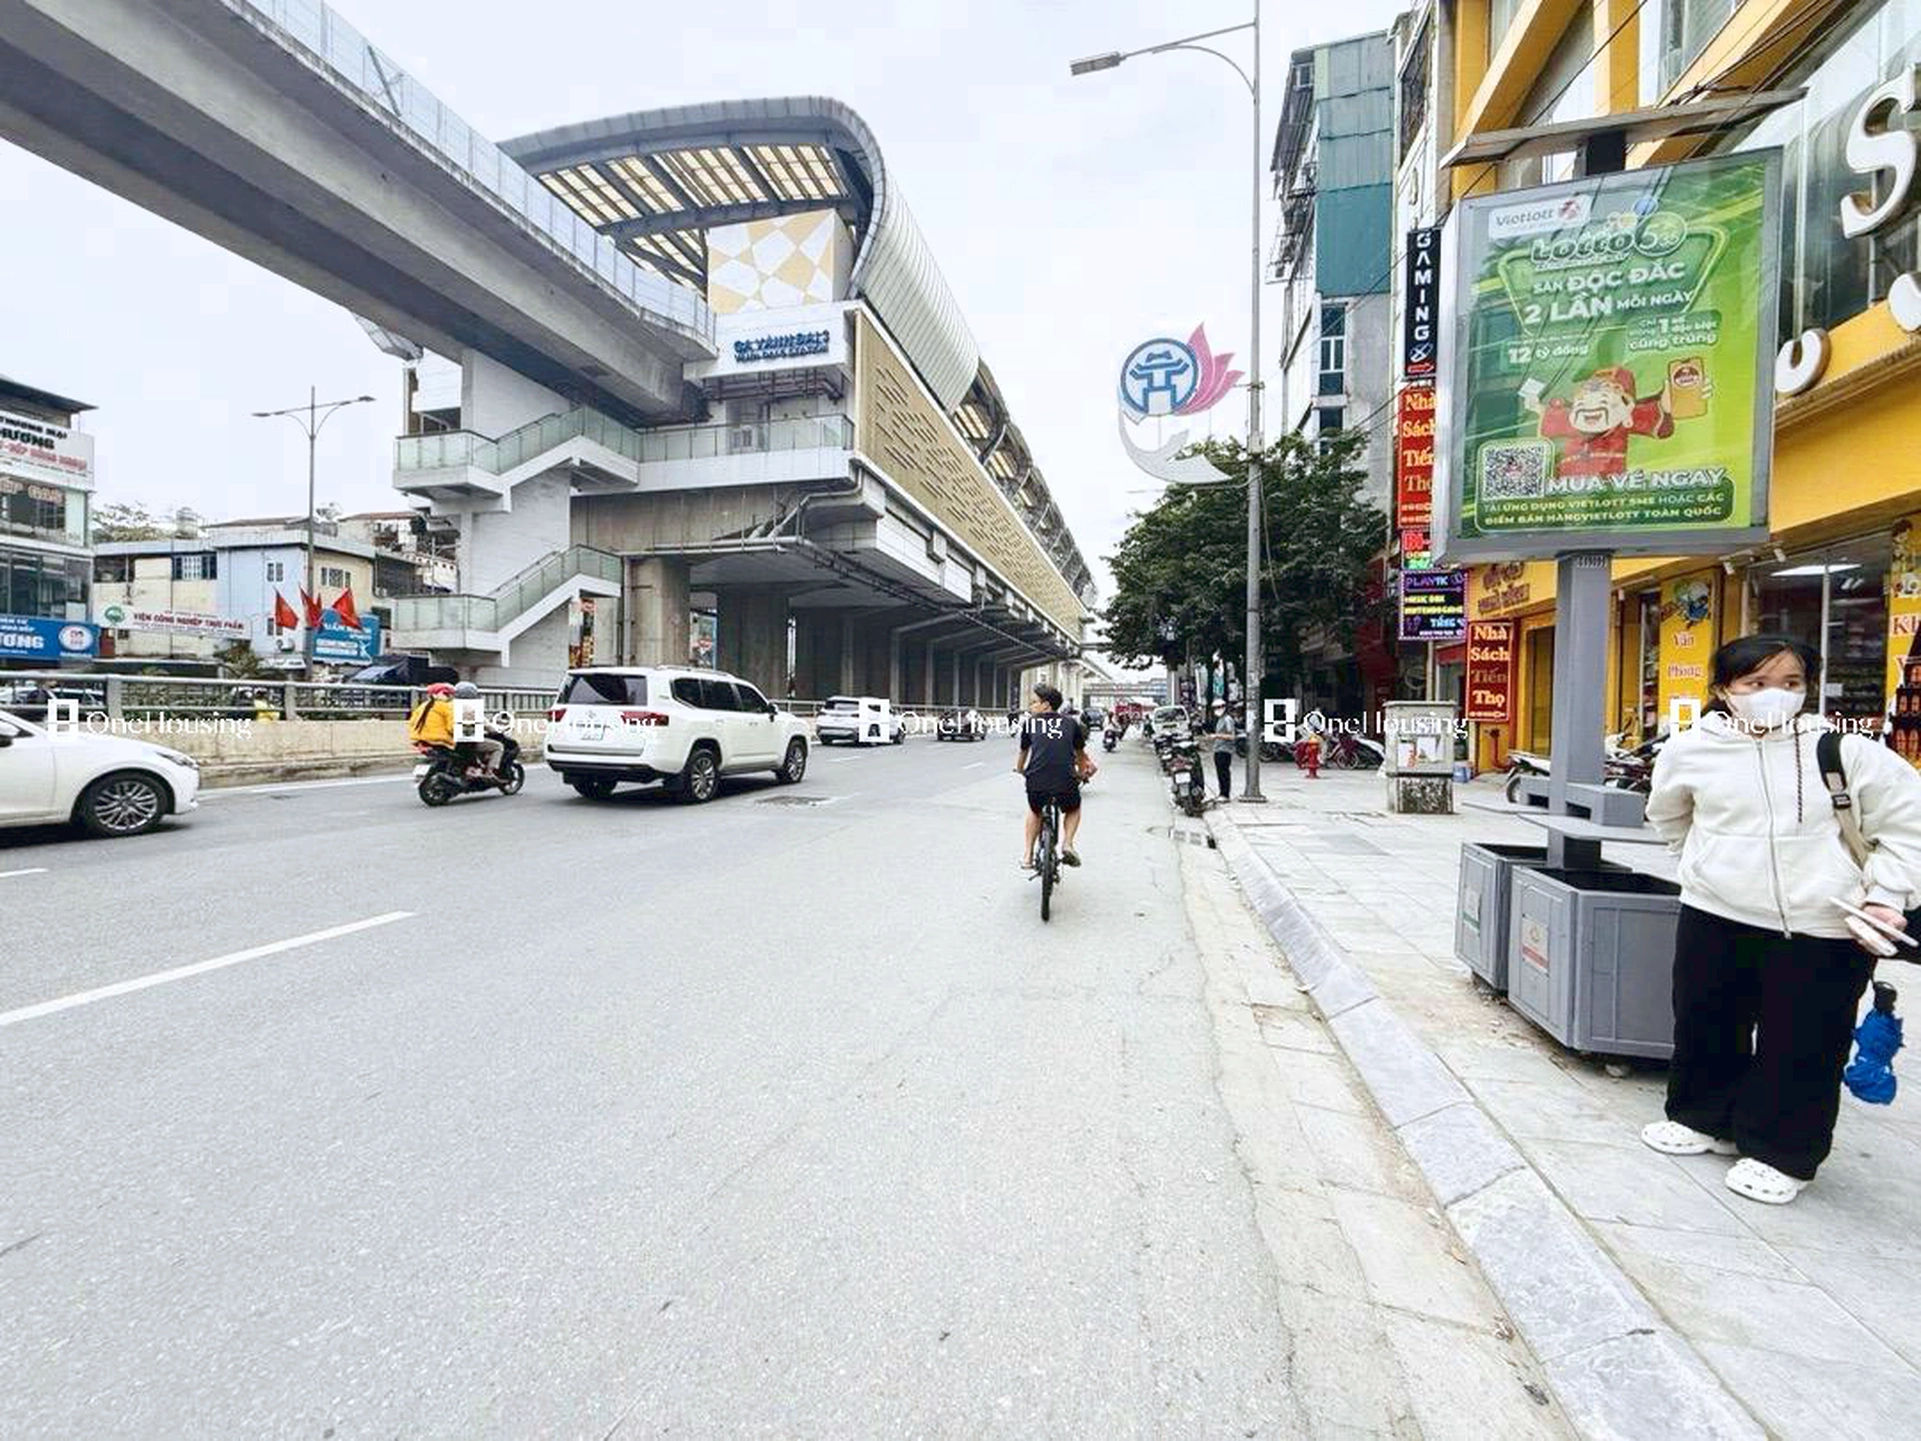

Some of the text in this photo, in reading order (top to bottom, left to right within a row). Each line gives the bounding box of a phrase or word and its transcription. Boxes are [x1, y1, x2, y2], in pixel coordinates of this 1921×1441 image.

[1567, 269, 1624, 294] ĐỘC
[1627, 258, 1686, 285] ĐẮC
[1414, 232, 1432, 341] GAMING
[1523, 305, 1542, 324] 2
[1549, 291, 1614, 323] LẦN
[1651, 289, 1696, 306] NGÀY
[1508, 346, 1533, 364] 12
[1547, 467, 1727, 495] MUA VÉ NGAY
[1568, 497, 1627, 510] VIETLOTT
[1473, 625, 1508, 641] Nhà
[1470, 646, 1511, 662] Sách
[1471, 667, 1508, 685] Tiến
[1472, 691, 1506, 707] Thọ
